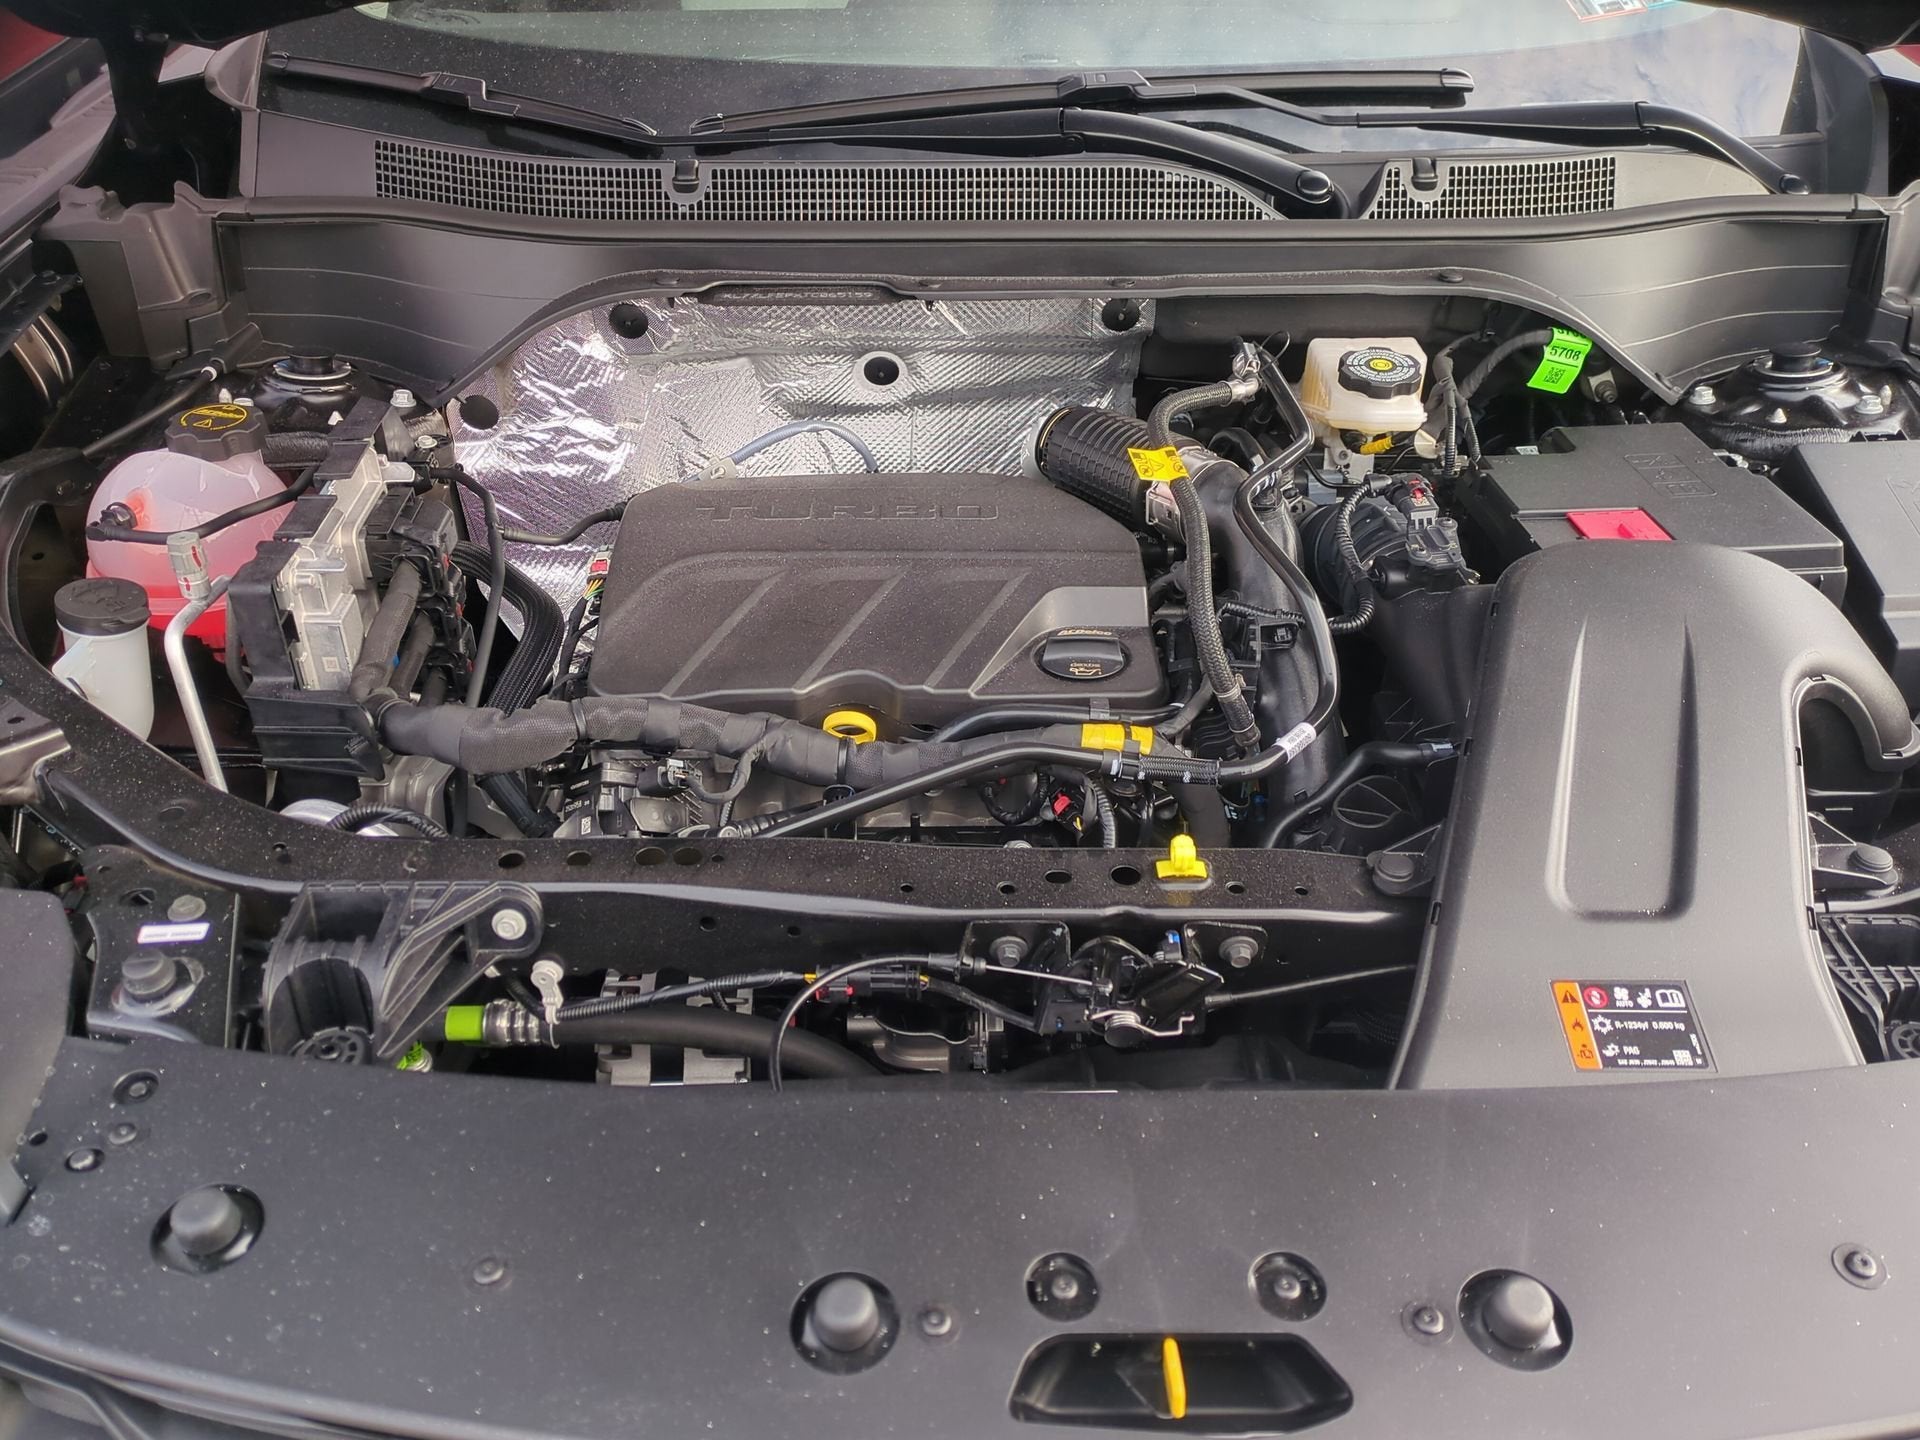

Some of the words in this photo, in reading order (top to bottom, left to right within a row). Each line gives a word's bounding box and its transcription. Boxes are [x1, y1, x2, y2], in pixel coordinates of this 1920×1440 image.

[1549, 345, 1582, 361] 5708
[695, 501, 1000, 521] TURBO
[1057, 628, 1113, 636] ACDelco
[1616, 1000, 1634, 1008] AUTO
[1614, 1021, 1650, 1031] R-1234yf
[1674, 1021, 1686, 1032] kg
[1623, 1045, 1640, 1056] PAG
